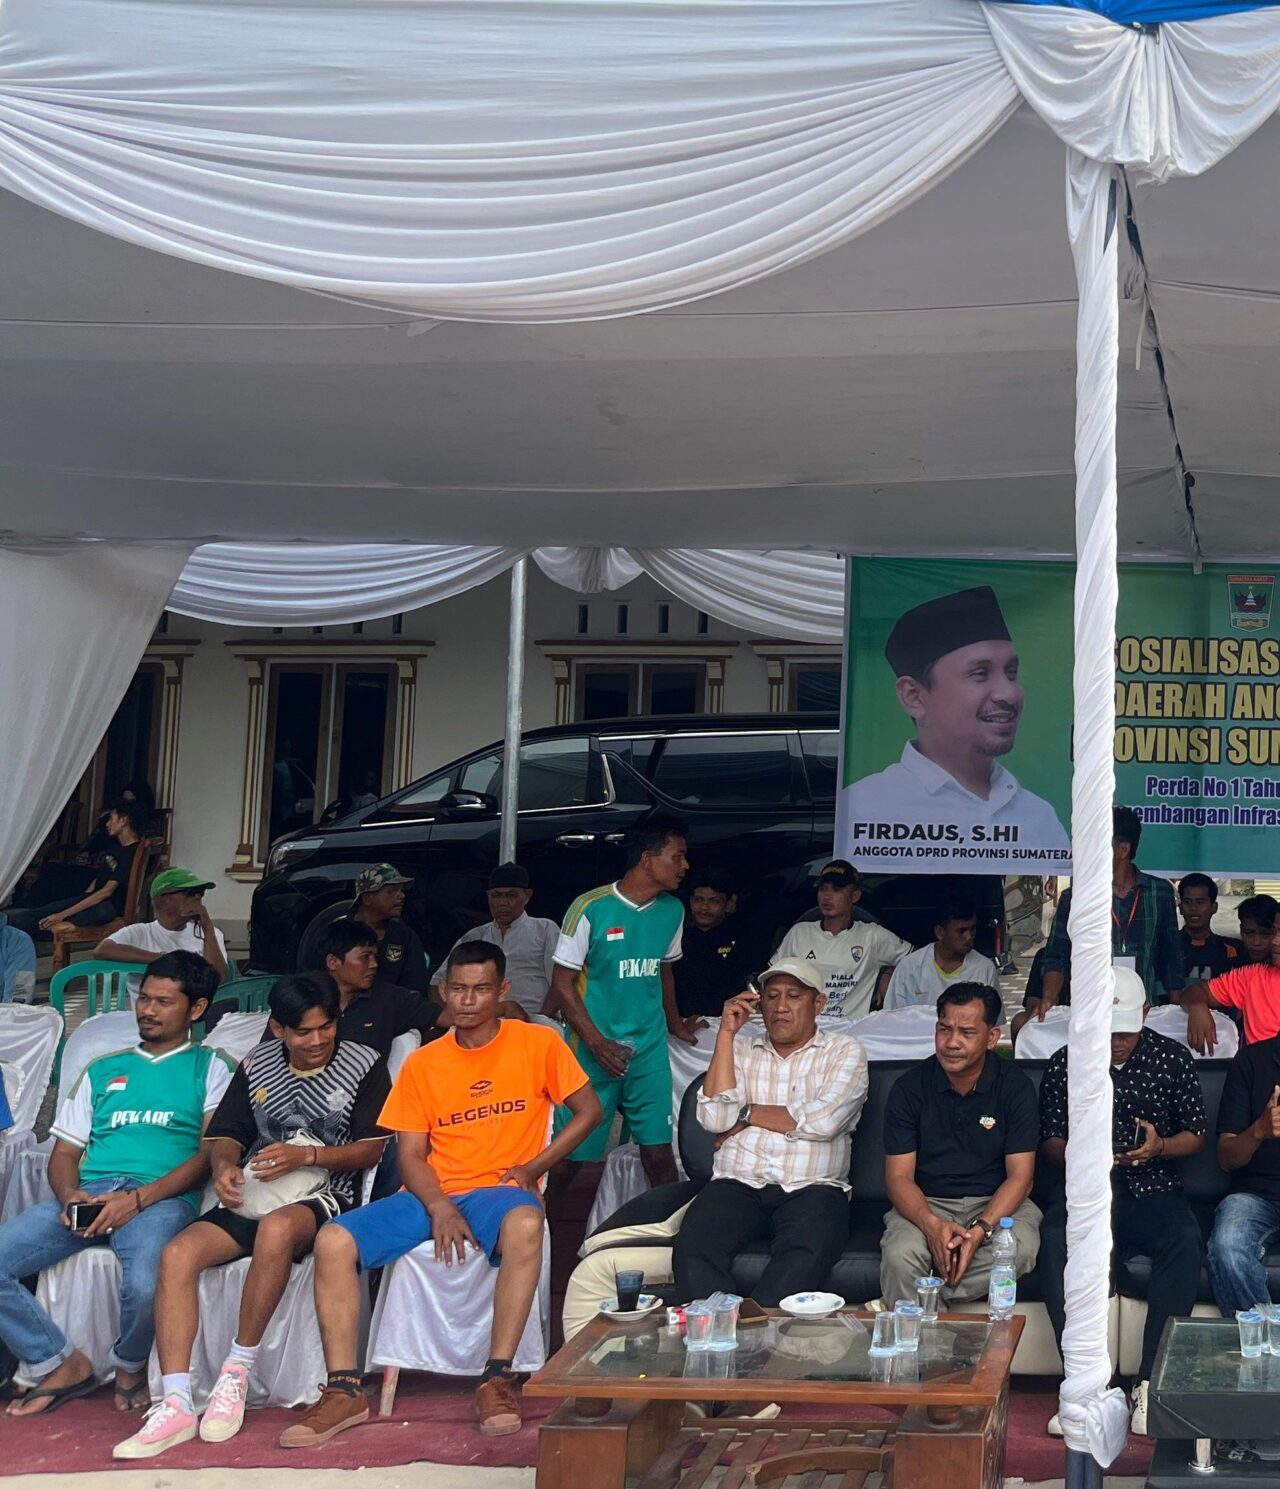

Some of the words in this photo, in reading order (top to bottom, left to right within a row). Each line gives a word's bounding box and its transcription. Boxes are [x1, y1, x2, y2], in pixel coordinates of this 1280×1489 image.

[1113, 725, 1222, 764] OVINSI
[1146, 775, 1200, 797] Perda
[1203, 777, 1227, 798] No
[1231, 778, 1240, 798] 1
[1134, 805, 1229, 826] embangan
[853, 822, 964, 844] FIRDAUS,
[971, 824, 1019, 842] S.HI
[853, 846, 913, 858] ANGGOTA
[916, 847, 950, 858] DPRD
[952, 848, 1009, 859] PROVINSI
[438, 1099, 526, 1128] LEGENDS
